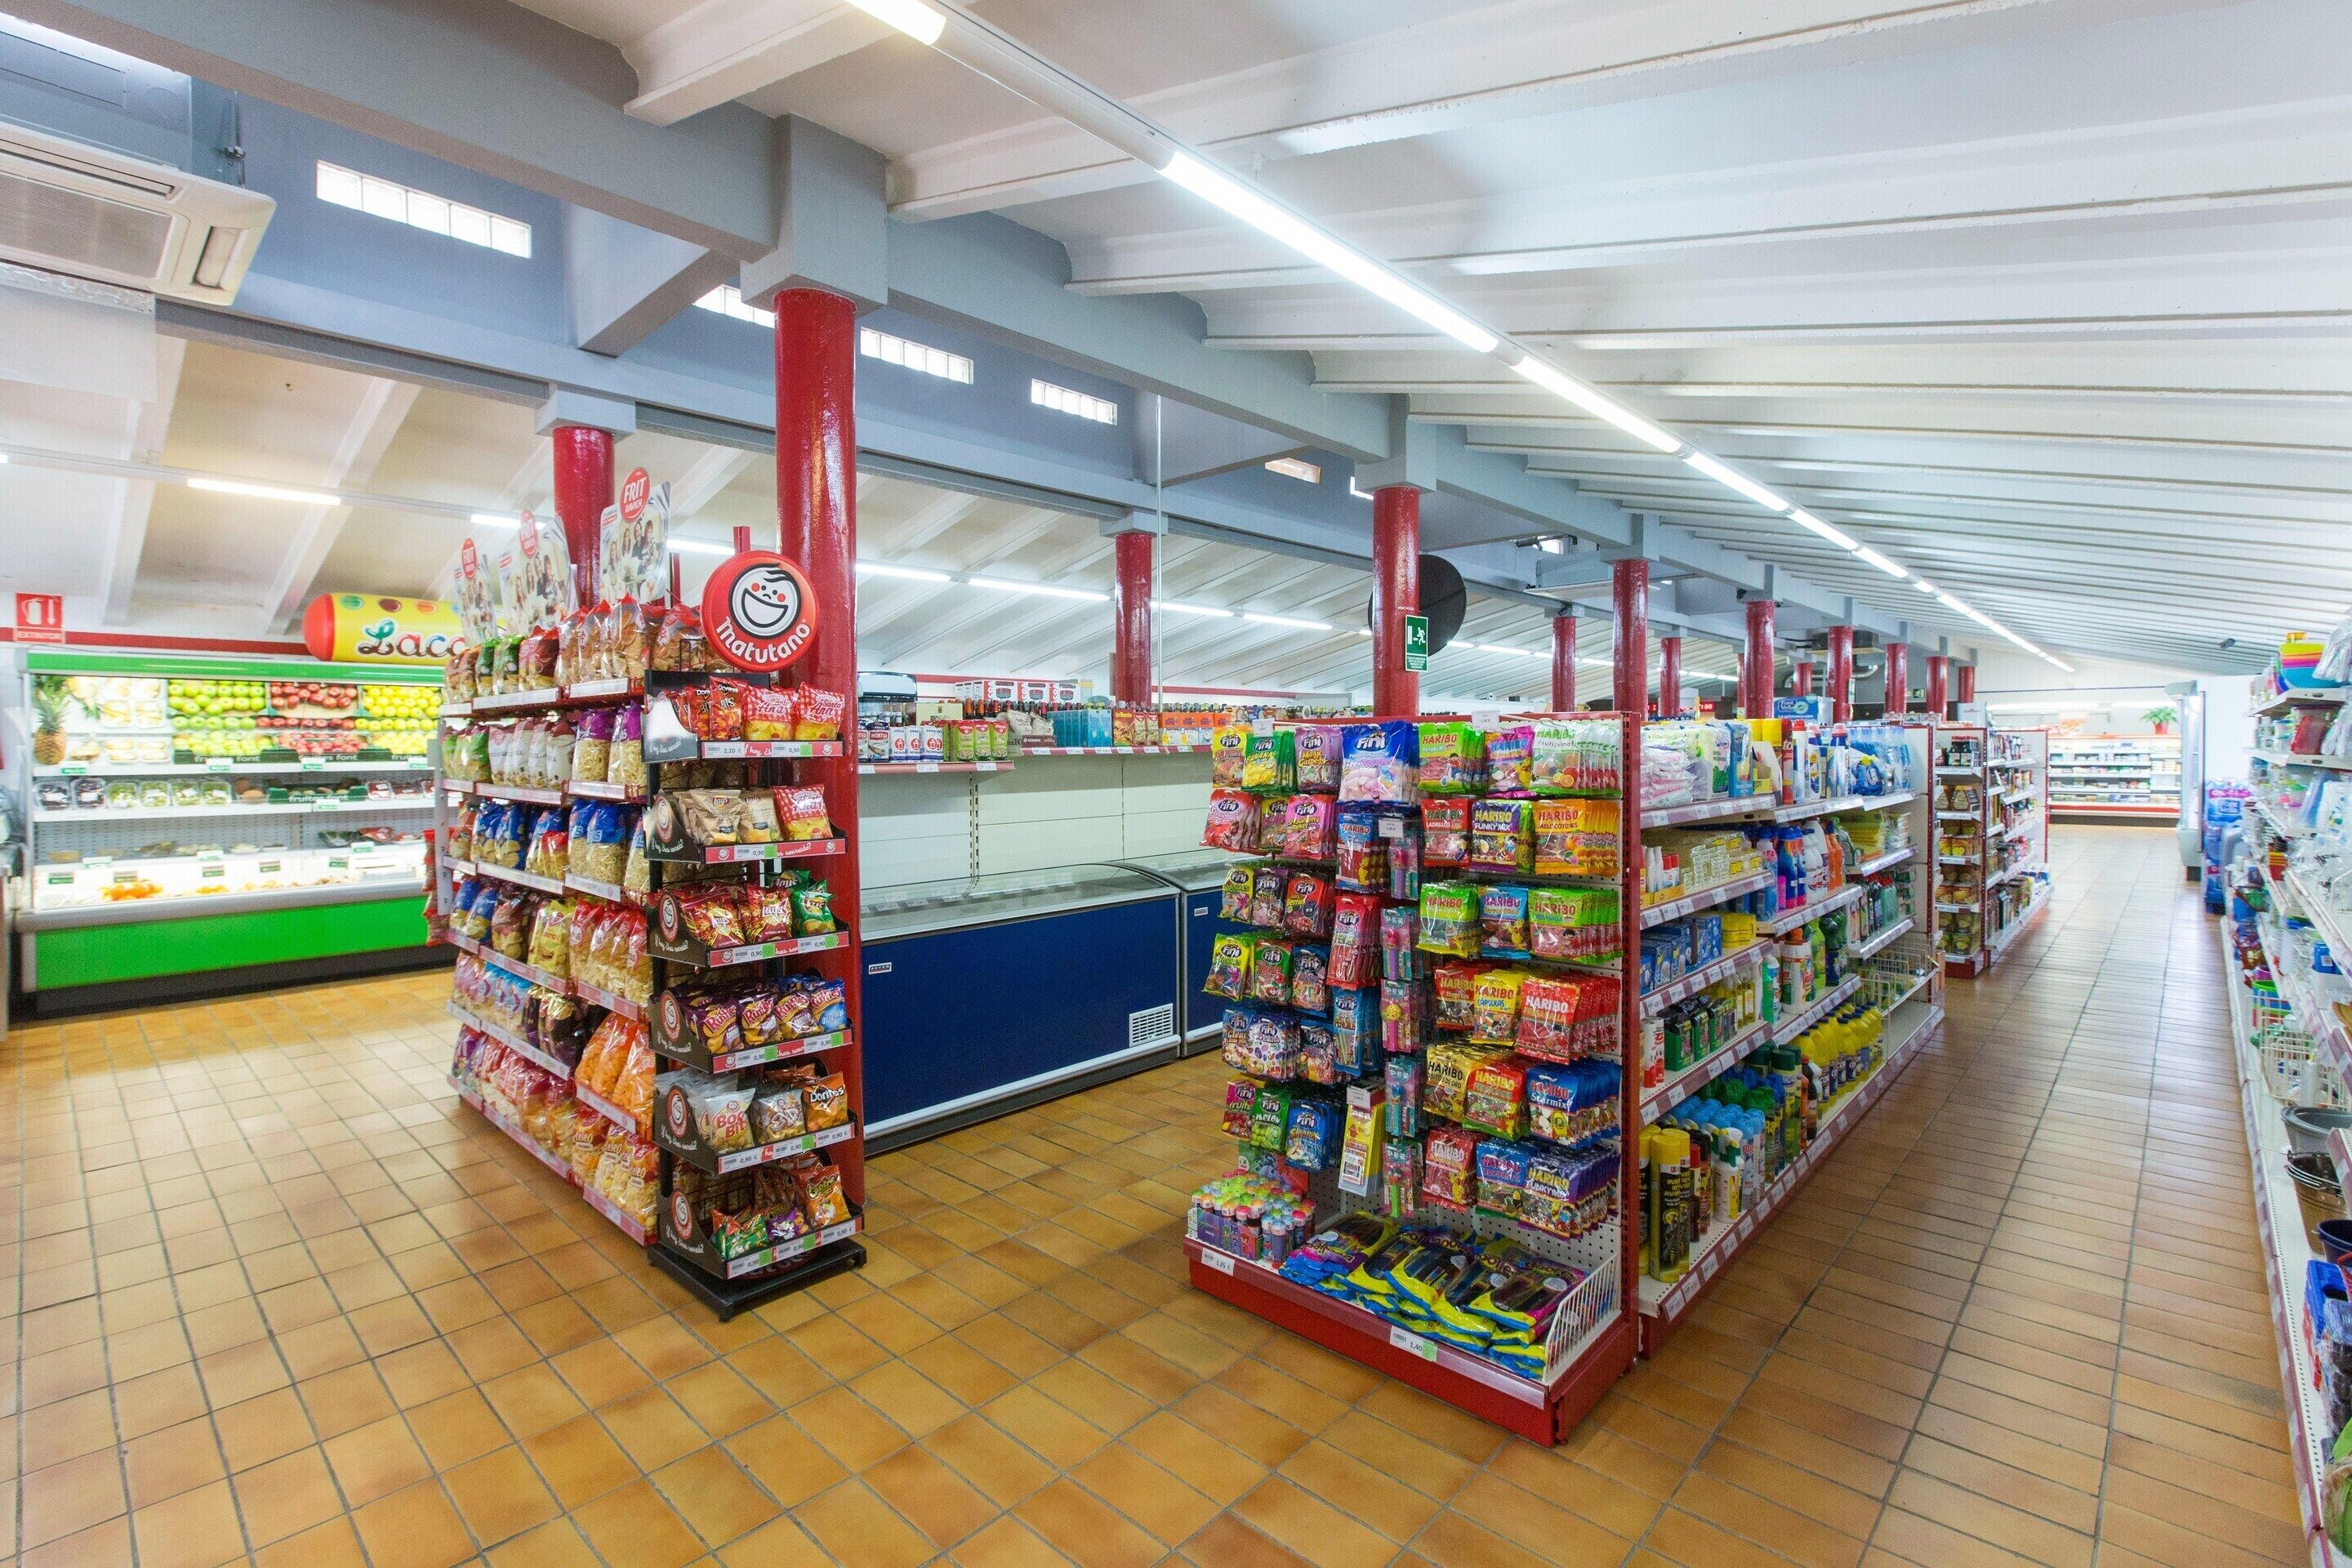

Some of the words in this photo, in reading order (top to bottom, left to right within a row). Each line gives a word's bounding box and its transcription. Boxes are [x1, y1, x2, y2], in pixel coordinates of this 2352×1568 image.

[623, 476, 648, 503] FRIT
[808, 702, 835, 716] Ana
[1222, 737, 1241, 747] Fini
[1303, 736, 1322, 748] Fini
[1356, 732, 1386, 750] Fini
[1422, 733, 1458, 744] HARIBO
[1490, 738, 1528, 751] HARIBO
[1255, 740, 1274, 751] Fini
[1219, 800, 1238, 811] Fini
[1297, 804, 1316, 815] Fini
[1426, 809, 1463, 821] HARIBO
[1475, 810, 1512, 822] HARIBO
[1538, 810, 1579, 822] HARIBO
[1342, 823, 1370, 834] HARIBO
[1232, 872, 1246, 883] Fini
[1296, 884, 1313, 894] Fini
[1425, 896, 1463, 908] HARIBO
[1483, 896, 1521, 908] HARIBO
[1535, 902, 1576, 915] HARIBO
[1339, 913, 1359, 924] Fini
[1222, 947, 1241, 957] Fini
[1264, 952, 1281, 963] Fini
[1476, 985, 1516, 1000] HARIBO
[1338, 998, 1356, 1009] Fini
[1525, 995, 1569, 1013] HARIBO
[1428, 1061, 1463, 1080] HARIBO
[1450, 1080, 1462, 1089] ORO
[1475, 1070, 1517, 1091] HARIBO
[809, 1087, 844, 1102] Doritos
[1236, 1087, 1253, 1099] Fini
[1530, 1080, 1570, 1100] HARIBO
[1262, 1100, 1280, 1111] Fini
[1530, 1092, 1569, 1109] Starmix
[1296, 1112, 1316, 1127] Fini
[1431, 1141, 1465, 1160] HARIBO
[740, 1155, 752, 1164] 0,90
[1528, 1168, 1570, 1190] HARIBO
[837, 1227, 849, 1236] 0,90
[793, 1243, 804, 1252] 0,90
[747, 1258, 760, 1267] 0,90
[1216, 1259, 1227, 1268] 1,25
[1410, 1342, 1423, 1352] 1,40
